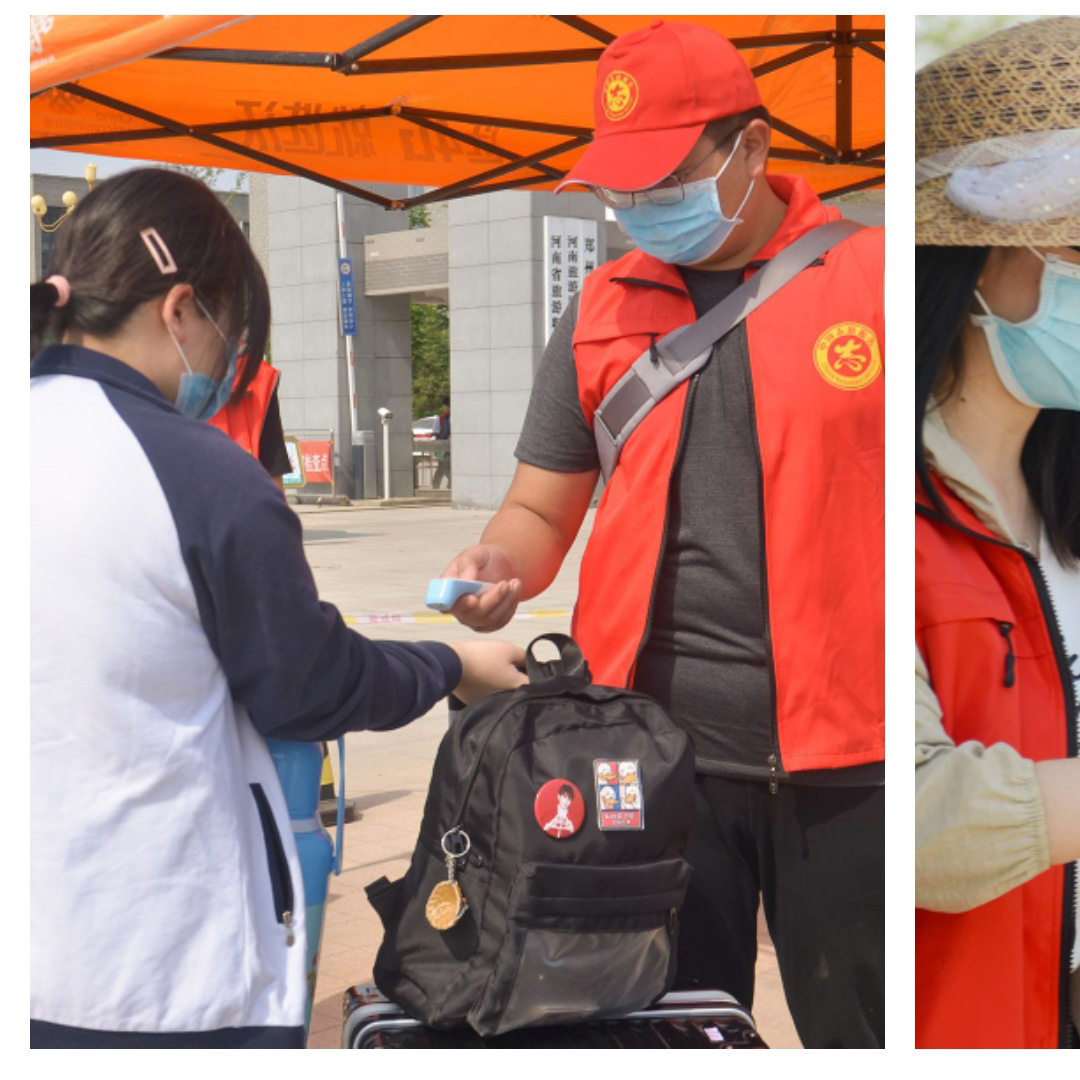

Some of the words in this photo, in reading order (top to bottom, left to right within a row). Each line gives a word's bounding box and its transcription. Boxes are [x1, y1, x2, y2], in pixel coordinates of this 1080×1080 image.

[567, 235, 579, 301] 河南旅游
[302, 453, 328, 472] 检查点
